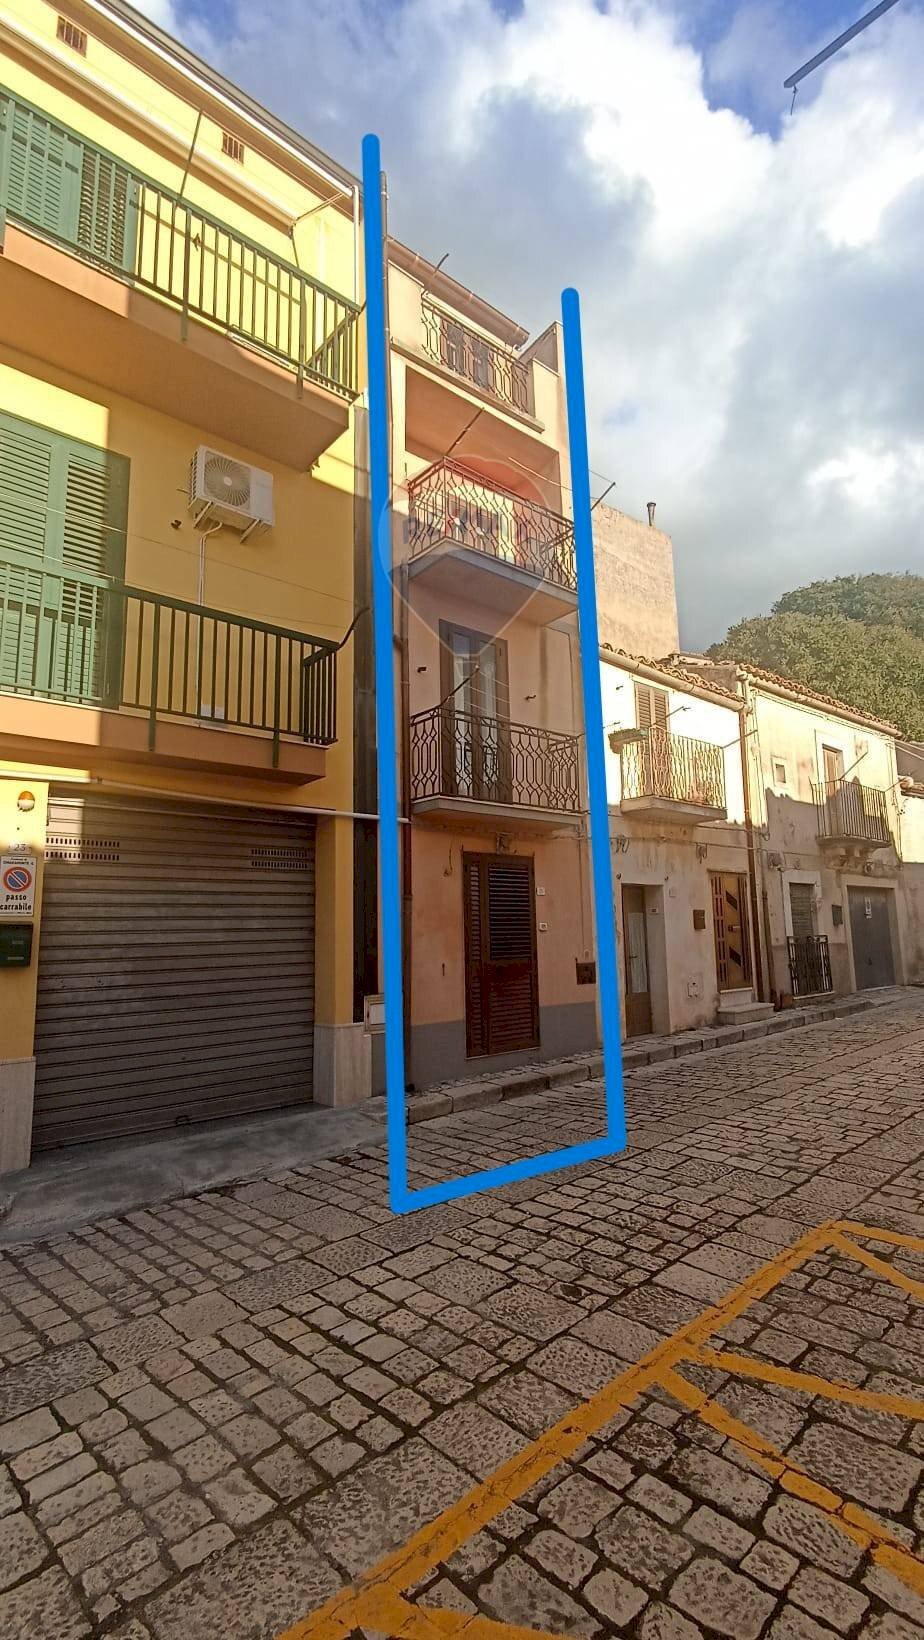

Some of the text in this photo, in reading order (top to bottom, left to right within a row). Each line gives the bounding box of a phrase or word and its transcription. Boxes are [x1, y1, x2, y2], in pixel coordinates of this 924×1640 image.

[14, 844, 26, 852] 23
[6, 894, 27, 902] passo
[0, 903, 32, 911] carrabile
